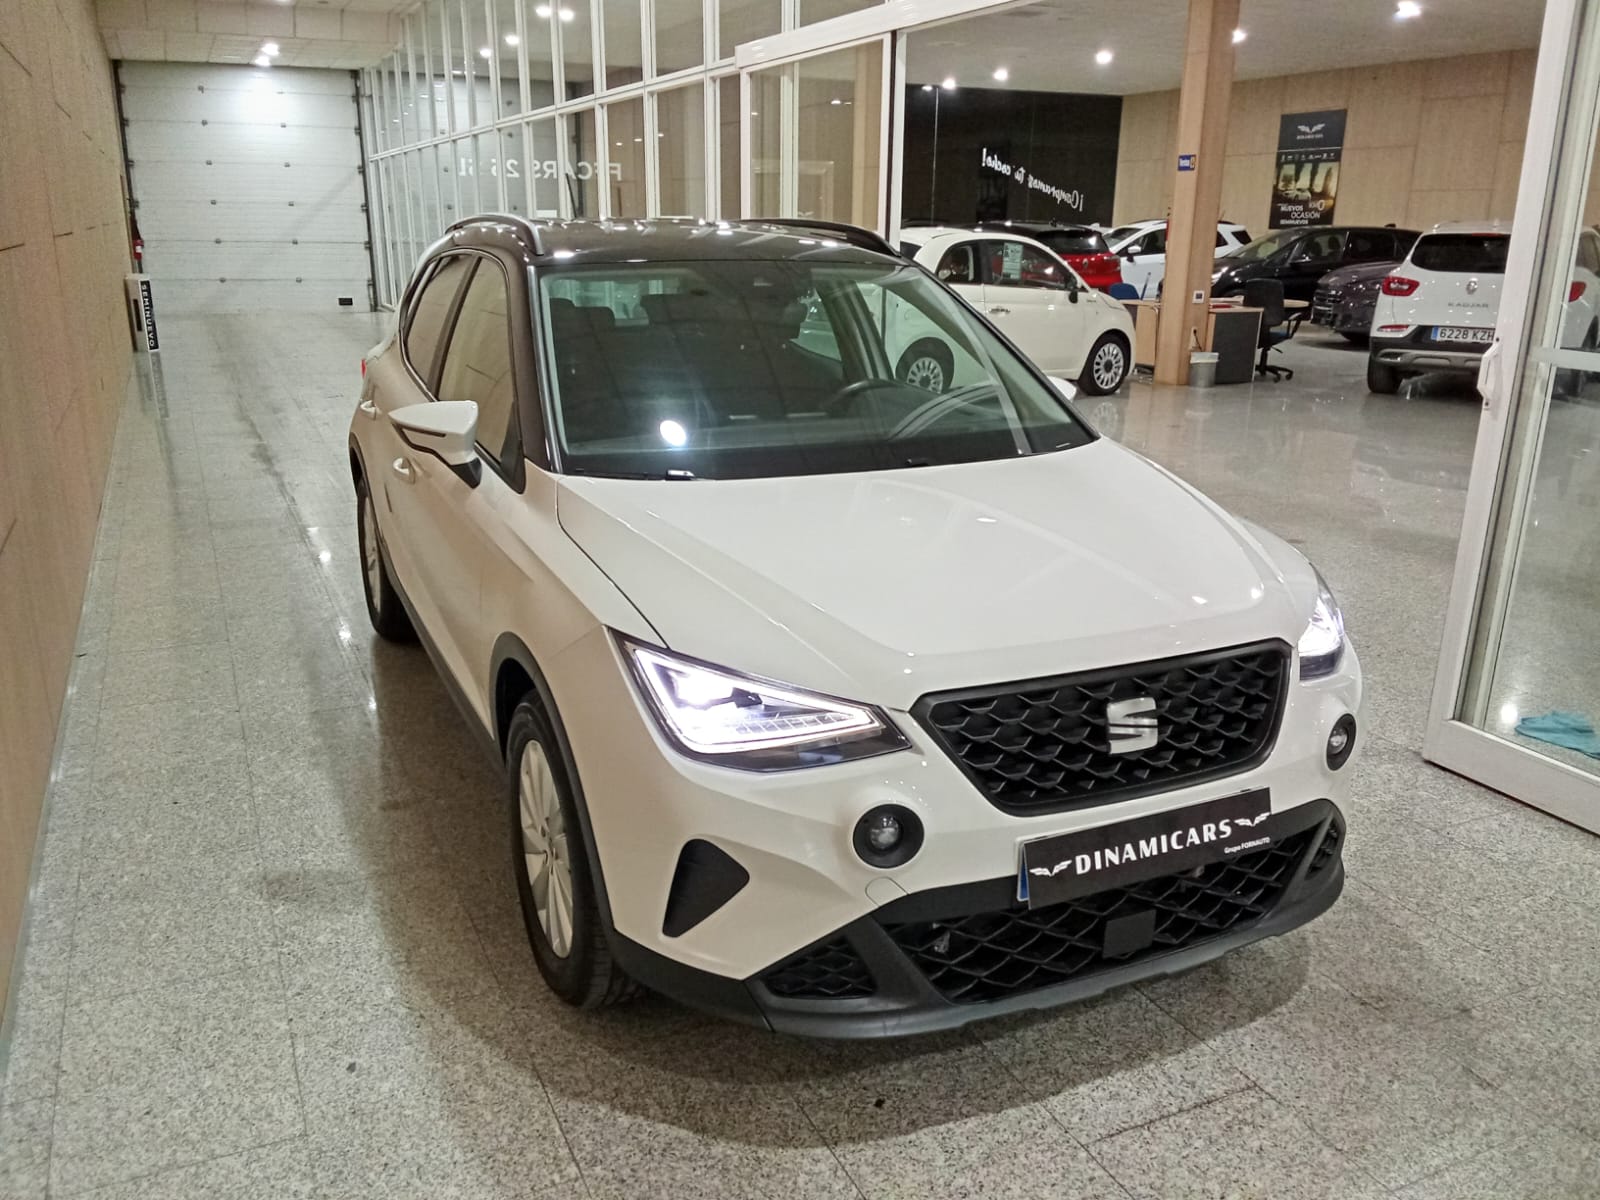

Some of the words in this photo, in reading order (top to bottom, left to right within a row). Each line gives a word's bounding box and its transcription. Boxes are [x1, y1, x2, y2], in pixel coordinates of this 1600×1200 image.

[141, 284, 155, 347] SEMINUEVO
[1439, 328, 1469, 340] 6228
[1471, 330, 1495, 342] KZH
[1074, 818, 1233, 876] DINAMICARS
